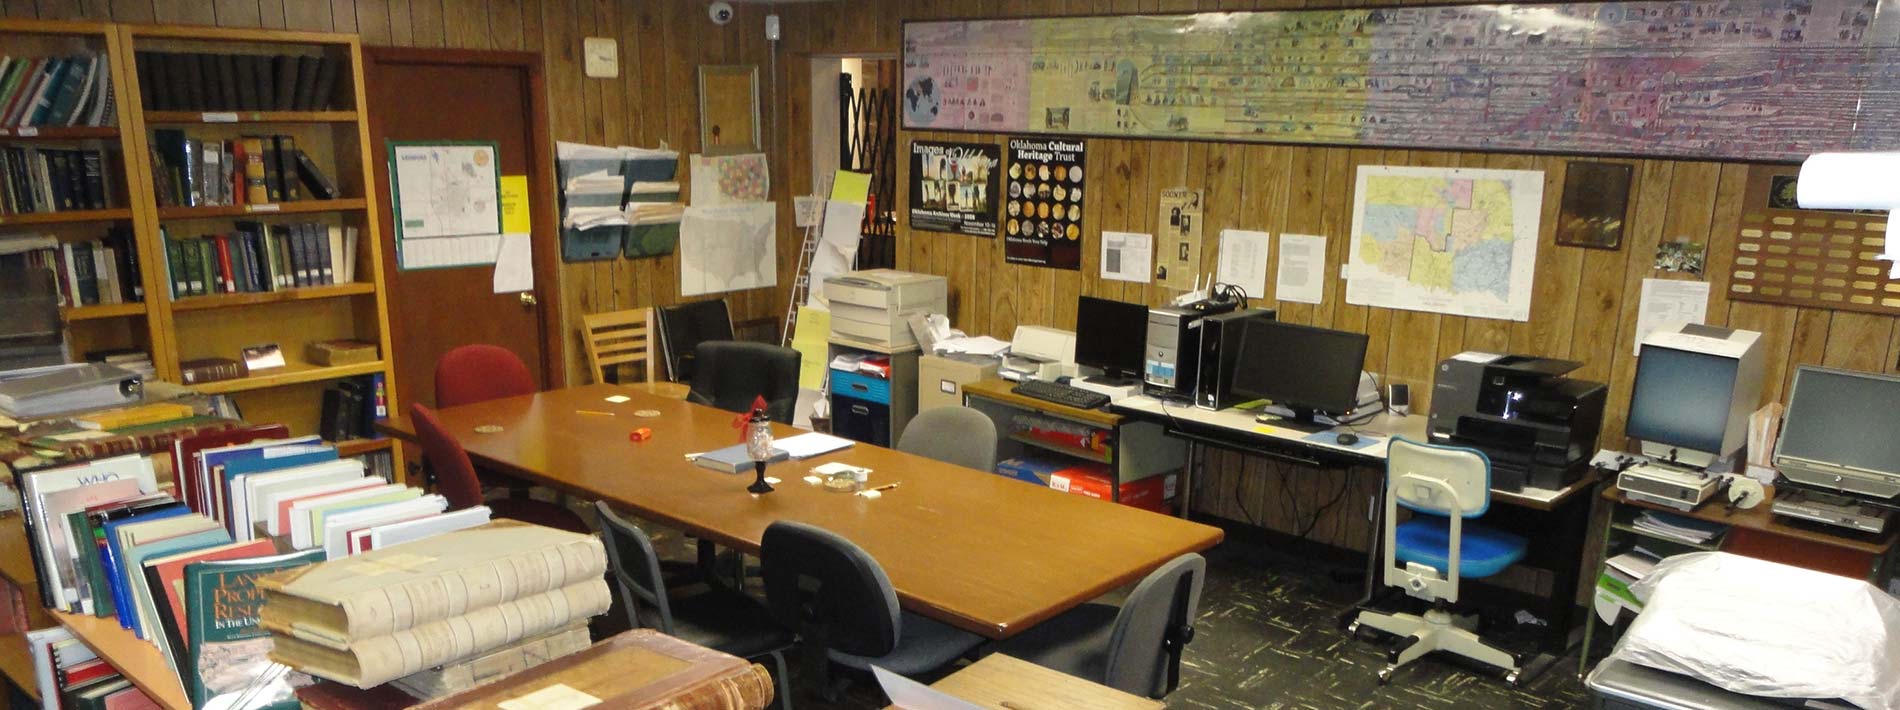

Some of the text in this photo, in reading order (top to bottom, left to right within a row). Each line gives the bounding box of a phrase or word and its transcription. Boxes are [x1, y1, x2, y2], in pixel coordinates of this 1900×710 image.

[913, 143, 944, 155] Images
[1010, 140, 1083, 152] Oklahoma Cultural
[1017, 150, 1075, 163] Heritage Trust
